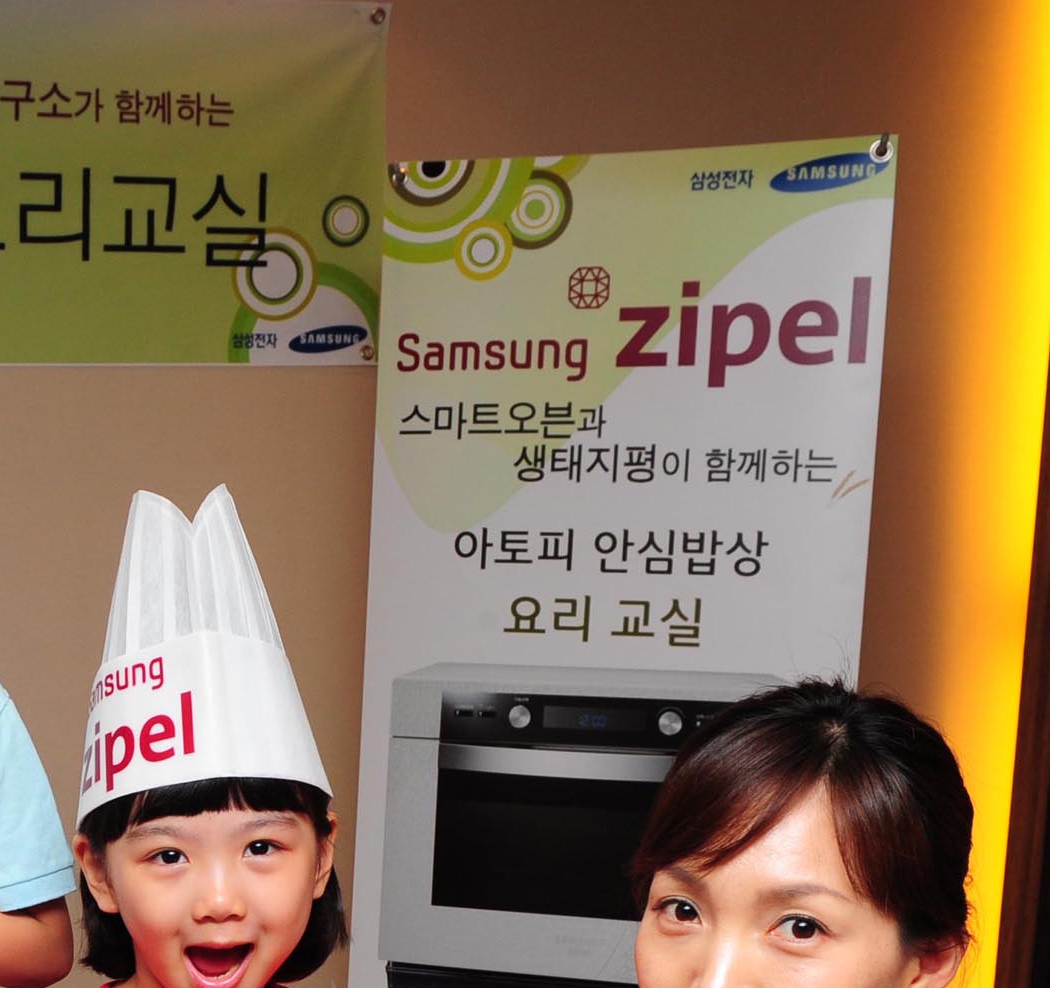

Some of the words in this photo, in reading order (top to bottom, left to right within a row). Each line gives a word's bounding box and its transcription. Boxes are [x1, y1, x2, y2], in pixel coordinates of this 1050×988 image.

[114, 88, 235, 128] 함께하는
[690, 169, 754, 191] 삼성전자
[785, 163, 878, 182] SAMSUNG
[232, 332, 278, 349] 삼성전자
[299, 333, 360, 345] SAMSUNG
[396, 332, 589, 382] Samsung
[615, 276, 872, 388] zipel
[398, 401, 607, 440] 스마트오븐과
[513, 443, 692, 483] 생태지평이
[705, 447, 838, 483] 함께하는
[453, 527, 575, 571] 아토피
[593, 528, 770, 577] 안심밥상
[503, 594, 593, 642] 요리
[610, 597, 703, 648] 교실
[82, 690, 195, 796] zipel
